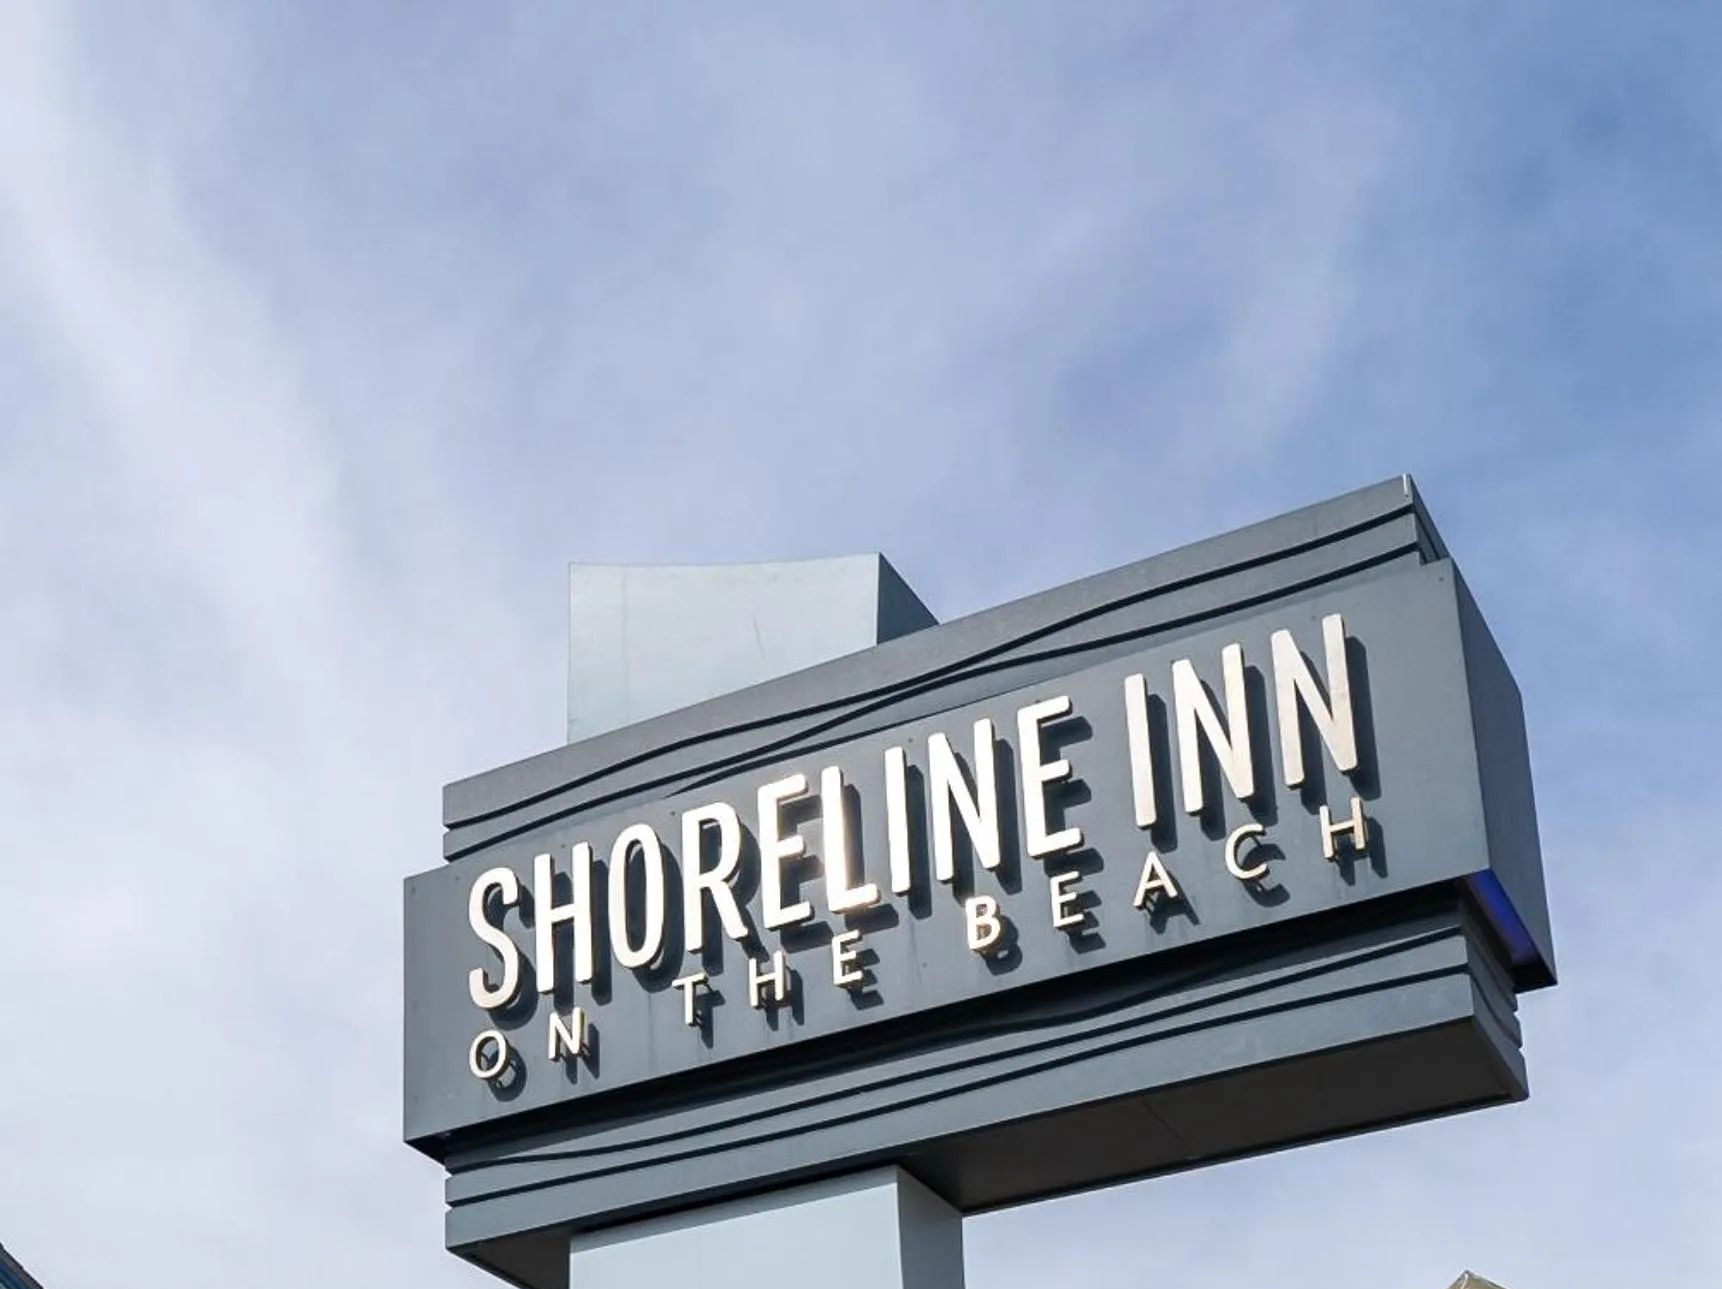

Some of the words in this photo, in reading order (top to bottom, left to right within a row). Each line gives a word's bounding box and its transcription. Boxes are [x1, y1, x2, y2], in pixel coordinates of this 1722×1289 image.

[468, 694, 1084, 1010] SHORELINE
[1123, 612, 1361, 829] INN
[468, 1007, 587, 1082] ON
[671, 928, 867, 1028] THE
[964, 796, 1369, 953] BEACH
